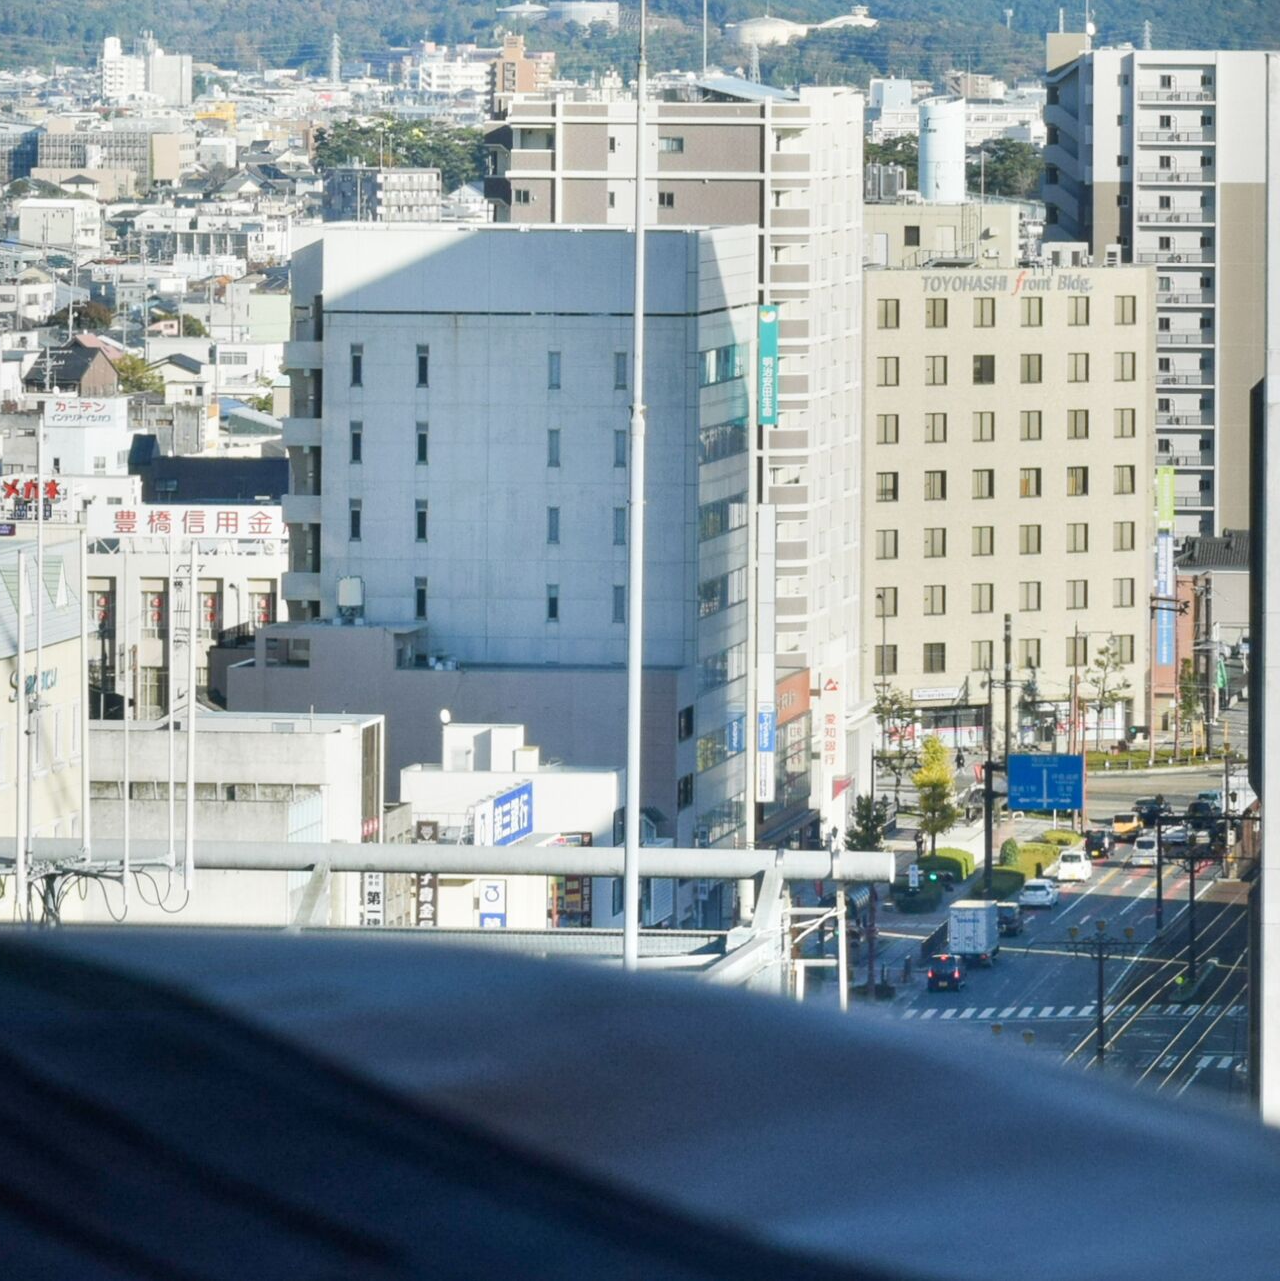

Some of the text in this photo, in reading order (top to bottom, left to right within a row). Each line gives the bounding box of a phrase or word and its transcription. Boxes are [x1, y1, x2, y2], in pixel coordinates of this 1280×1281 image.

[922, 270, 1093, 296] TOYOHASHI front Bldg.
[55, 401, 106, 413] カーテン
[113, 510, 289, 535] 豊橋信用金
